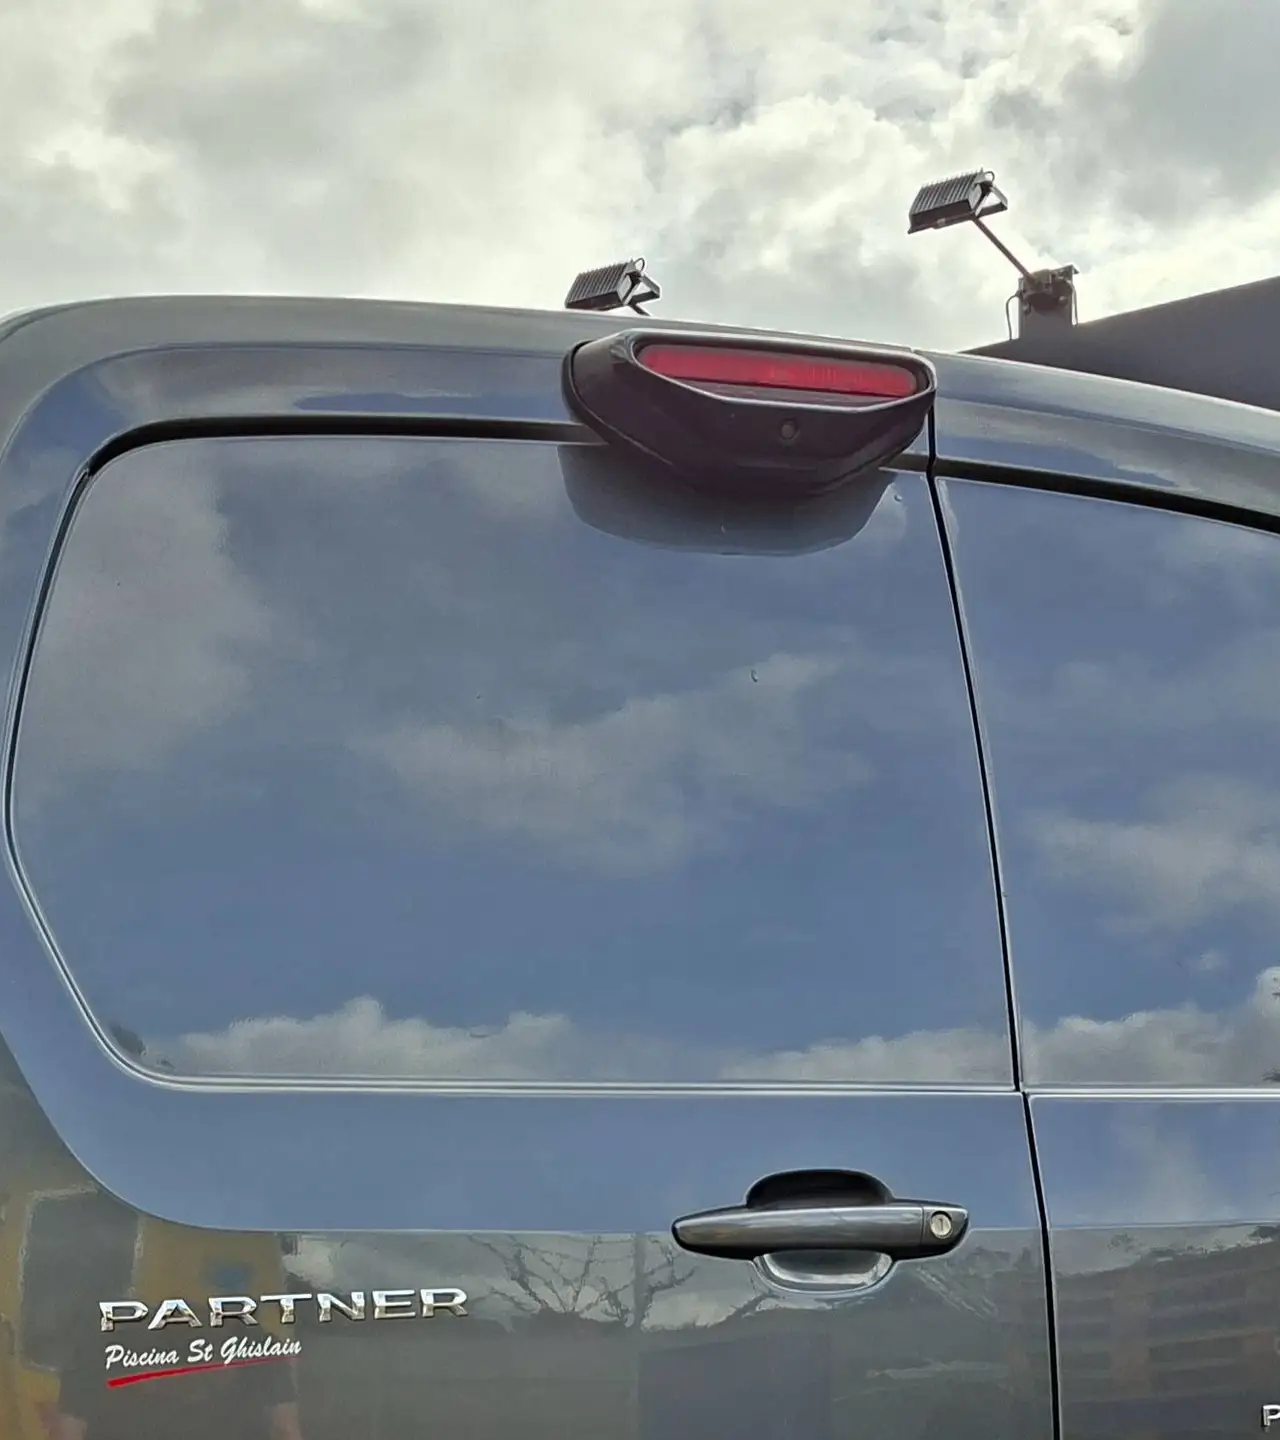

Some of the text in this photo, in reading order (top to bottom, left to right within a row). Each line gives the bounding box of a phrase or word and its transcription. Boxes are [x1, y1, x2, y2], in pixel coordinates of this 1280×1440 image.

[99, 1288, 469, 1332] PARTNER
[105, 1336, 302, 1370] Piscina St Ghislain
